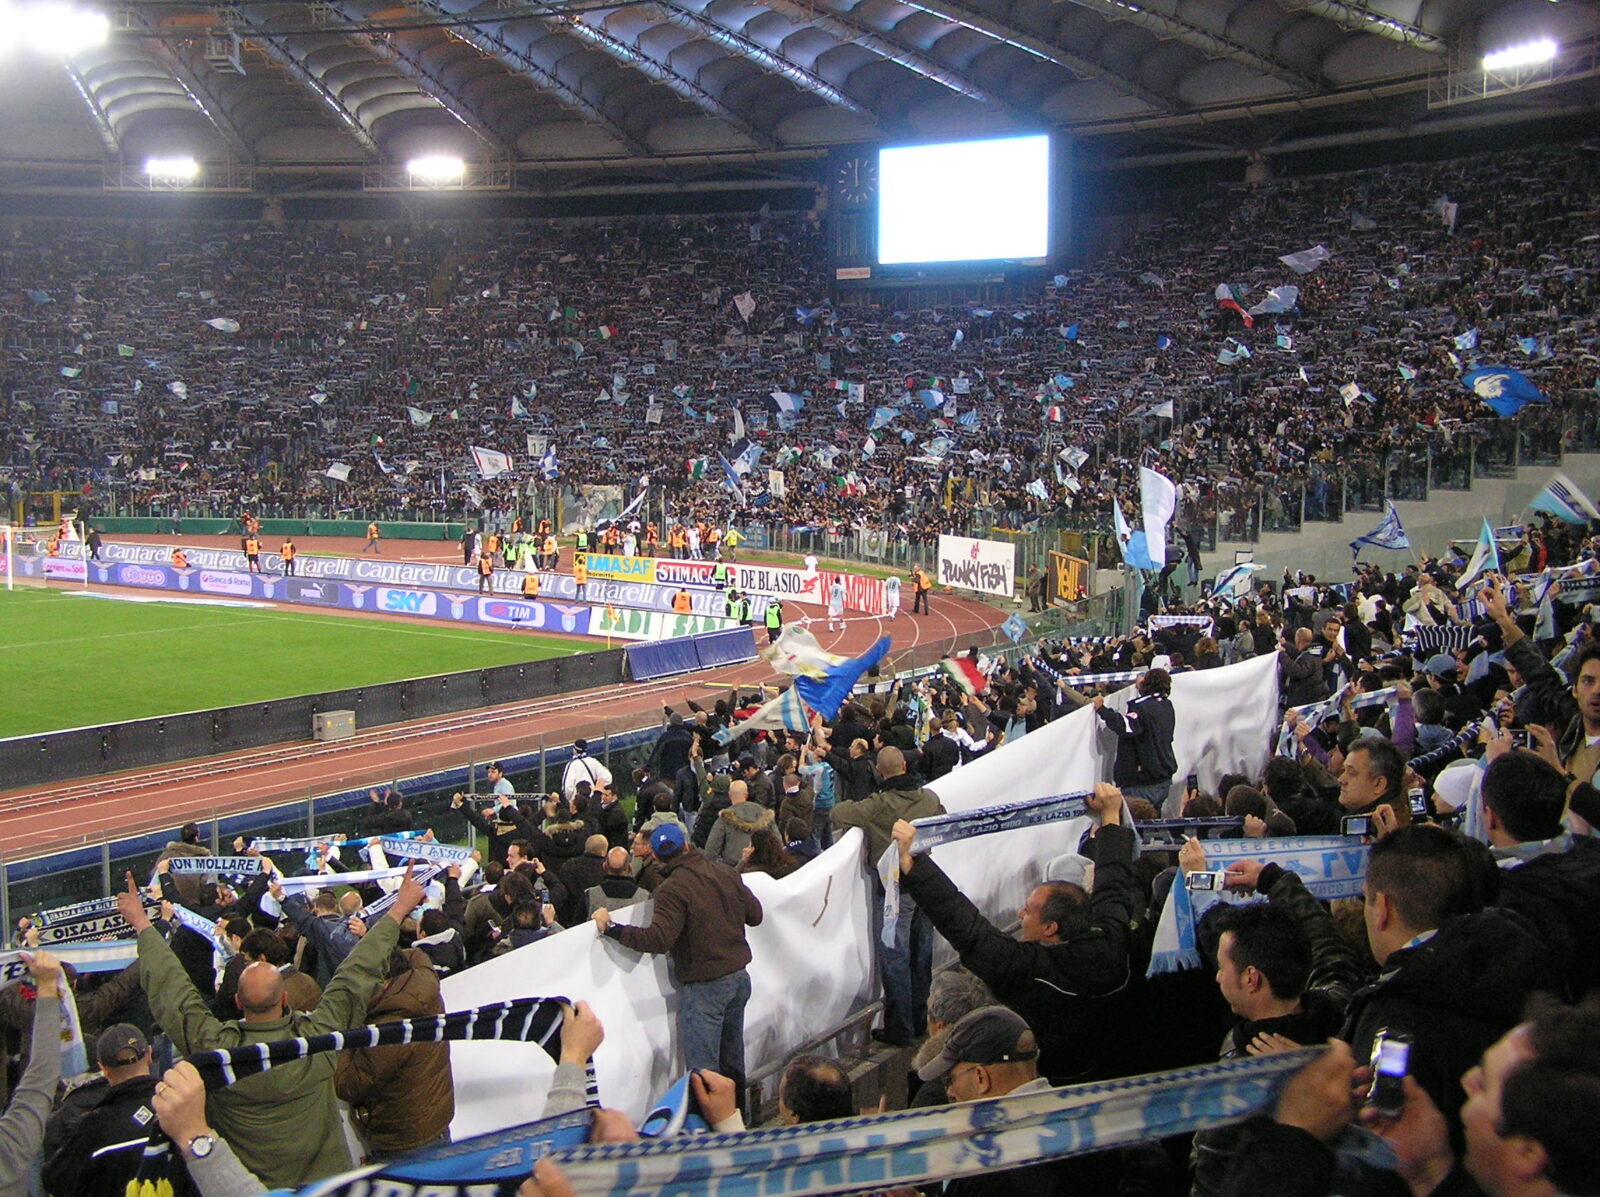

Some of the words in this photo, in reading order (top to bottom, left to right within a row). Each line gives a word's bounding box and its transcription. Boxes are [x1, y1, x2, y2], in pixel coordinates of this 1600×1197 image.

[208, 575, 227, 585] Banca
[228, 576, 233, 585] di
[234, 576, 251, 588] Roma
[356, 561, 449, 584] Cantarelli
[741, 569, 758, 590] DE
[759, 571, 801, 595] BLASIO
[386, 590, 428, 611] SKY
[560, 577, 656, 604] Cntarelli
[819, 572, 883, 615] WMPUM
[508, 605, 531, 619] TIM
[599, 608, 651, 635] SADI
[671, 614, 725, 637] SADI
[1046, 810, 1071, 821] LAZIO
[971, 823, 998, 834] LAZIO
[195, 858, 254, 872] MOLLARE
